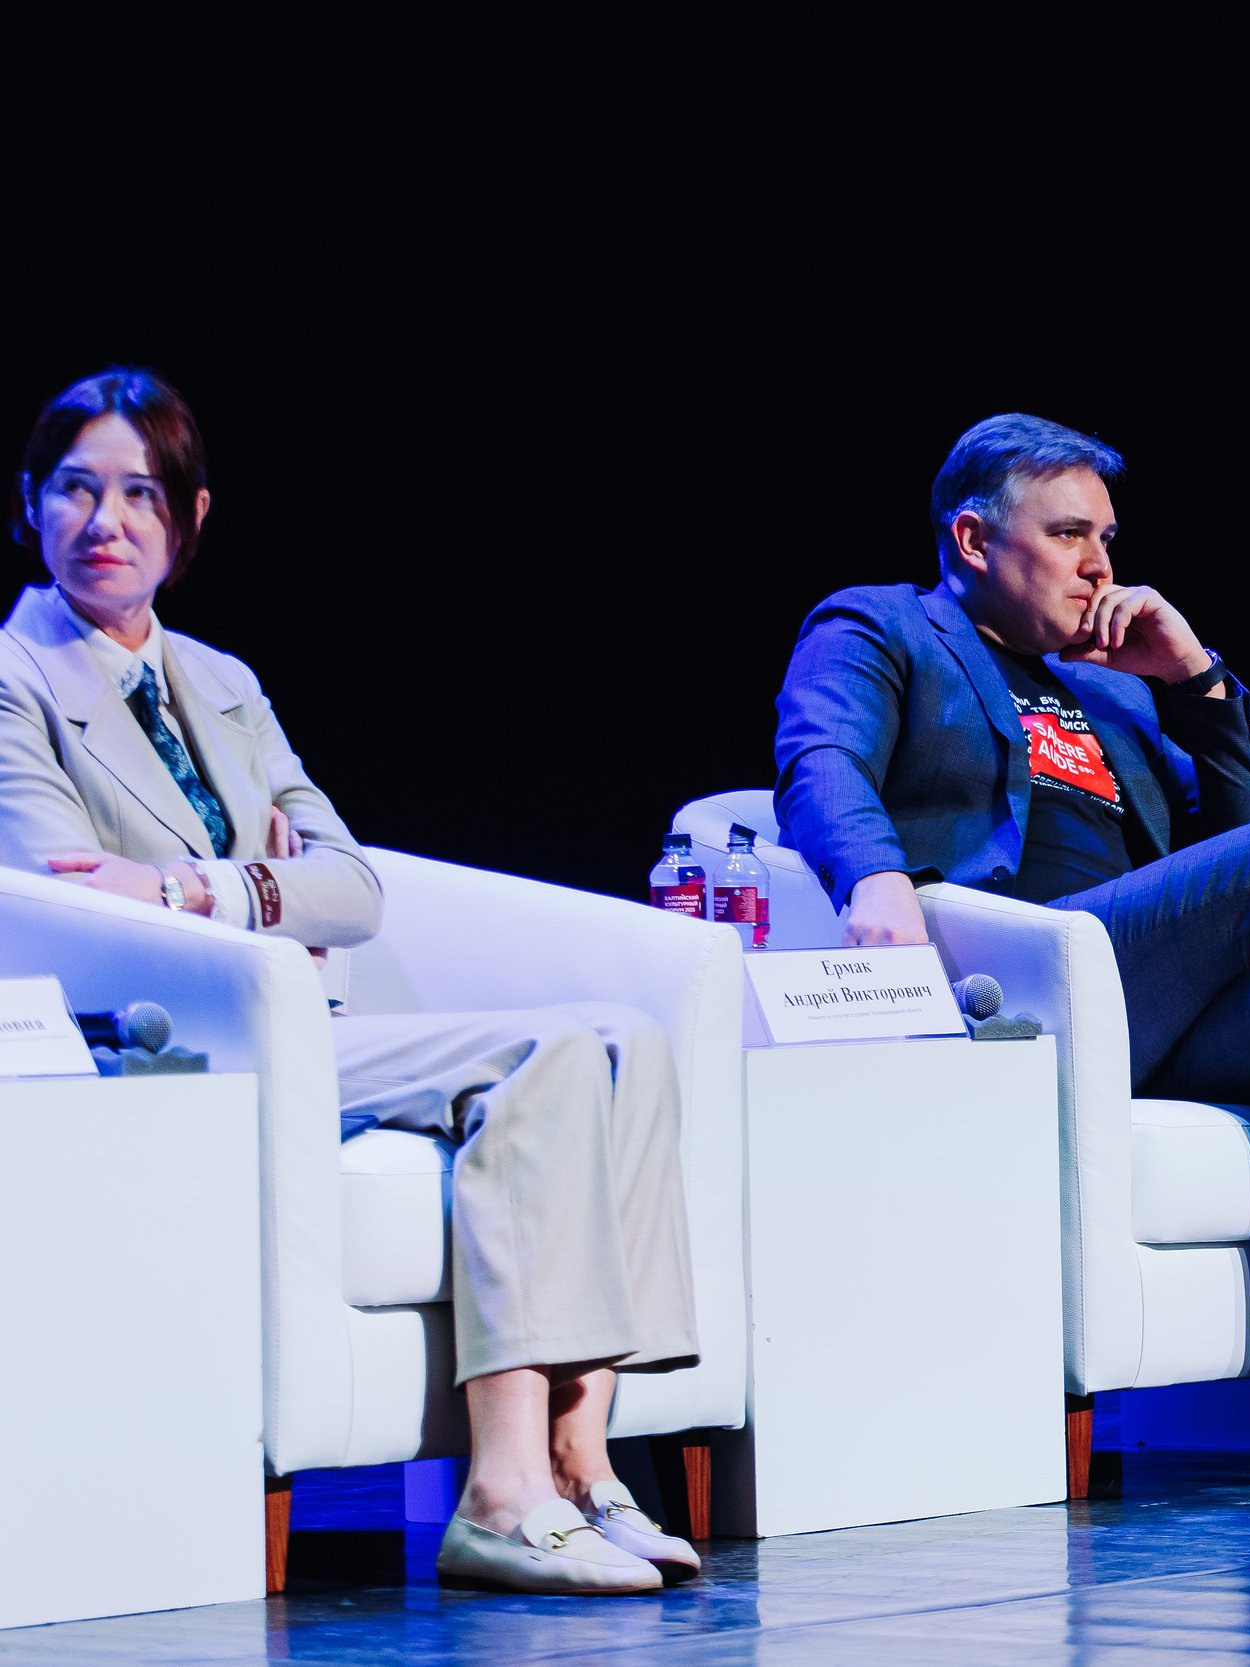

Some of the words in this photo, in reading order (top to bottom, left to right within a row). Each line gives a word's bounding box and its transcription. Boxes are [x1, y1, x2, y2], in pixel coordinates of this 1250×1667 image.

[821, 960, 873, 979] Ермак
[784, 987, 840, 1009] Андрей
[840, 984, 933, 1004] Викторович
